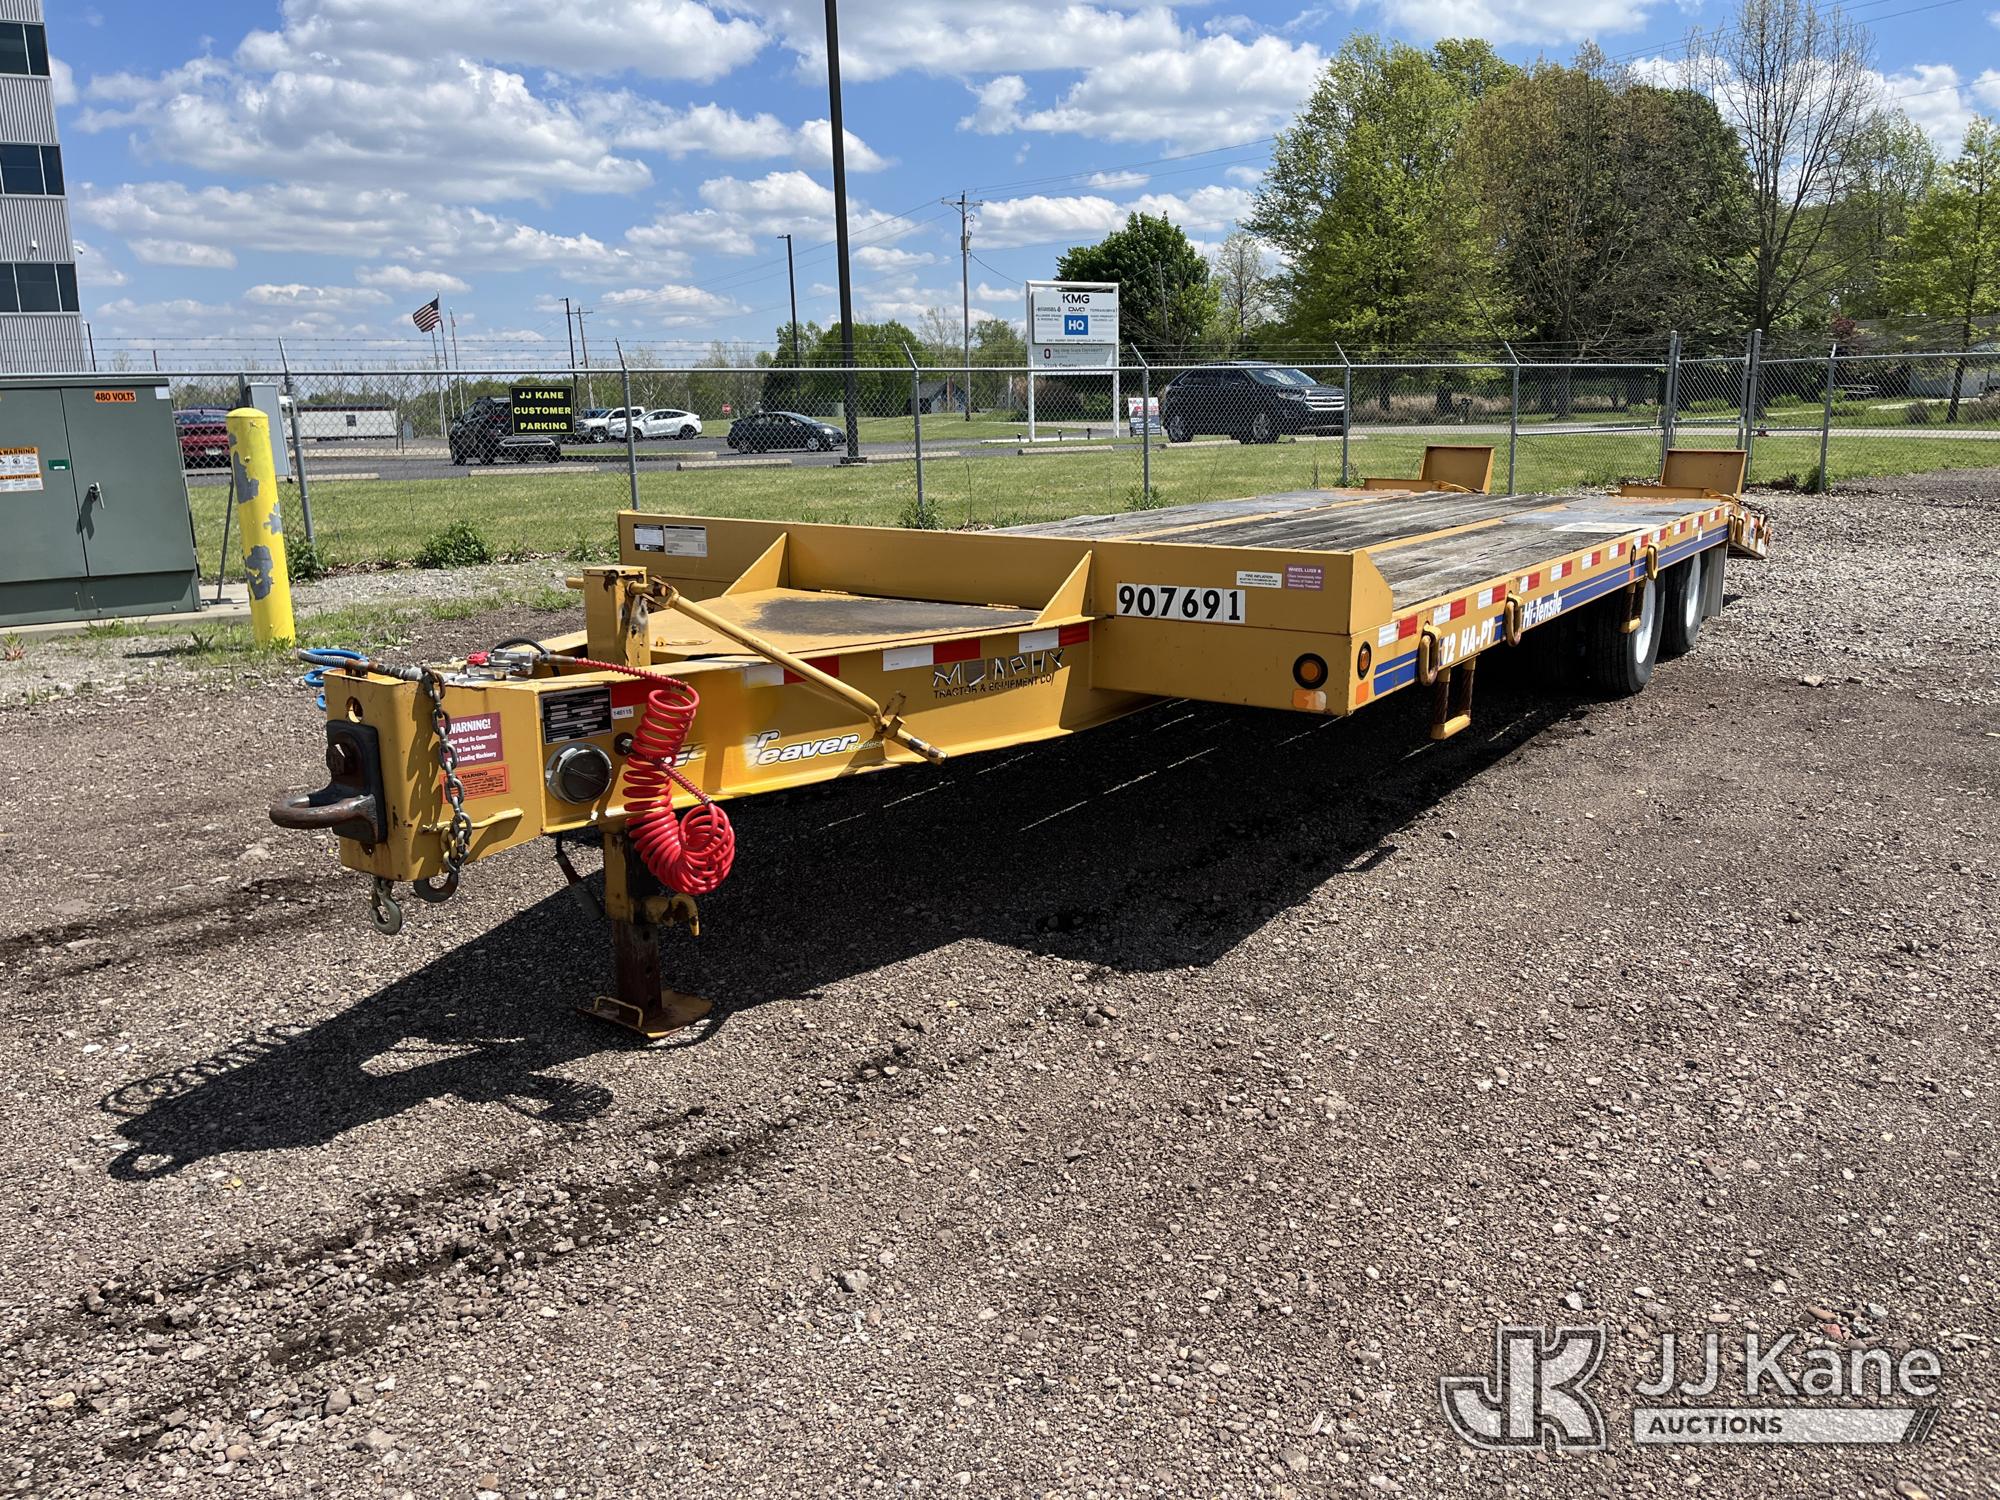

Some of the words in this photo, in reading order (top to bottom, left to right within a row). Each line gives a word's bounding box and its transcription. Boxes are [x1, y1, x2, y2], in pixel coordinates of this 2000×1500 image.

[1062, 294, 1090, 304] KMG
[1068, 320, 1085, 331] HQ
[95, 392, 111, 401] 480
[112, 392, 135, 401] VOLTS
[519, 391, 532, 399] JJ
[535, 391, 564, 399] KANE
[513, 406, 572, 415] CUSTOMER
[520, 422, 567, 430] PARKING
[3, 447, 36, 455] WARNING
[1118, 585, 1241, 621] 907691
[1522, 589, 1563, 629] Hi-Tensile
[1459, 617, 1496, 658] HA-PT
[933, 684, 978, 699] TRACTOR
[979, 683, 986, 693] &
[988, 676, 1039, 692] EQUIPMENT
